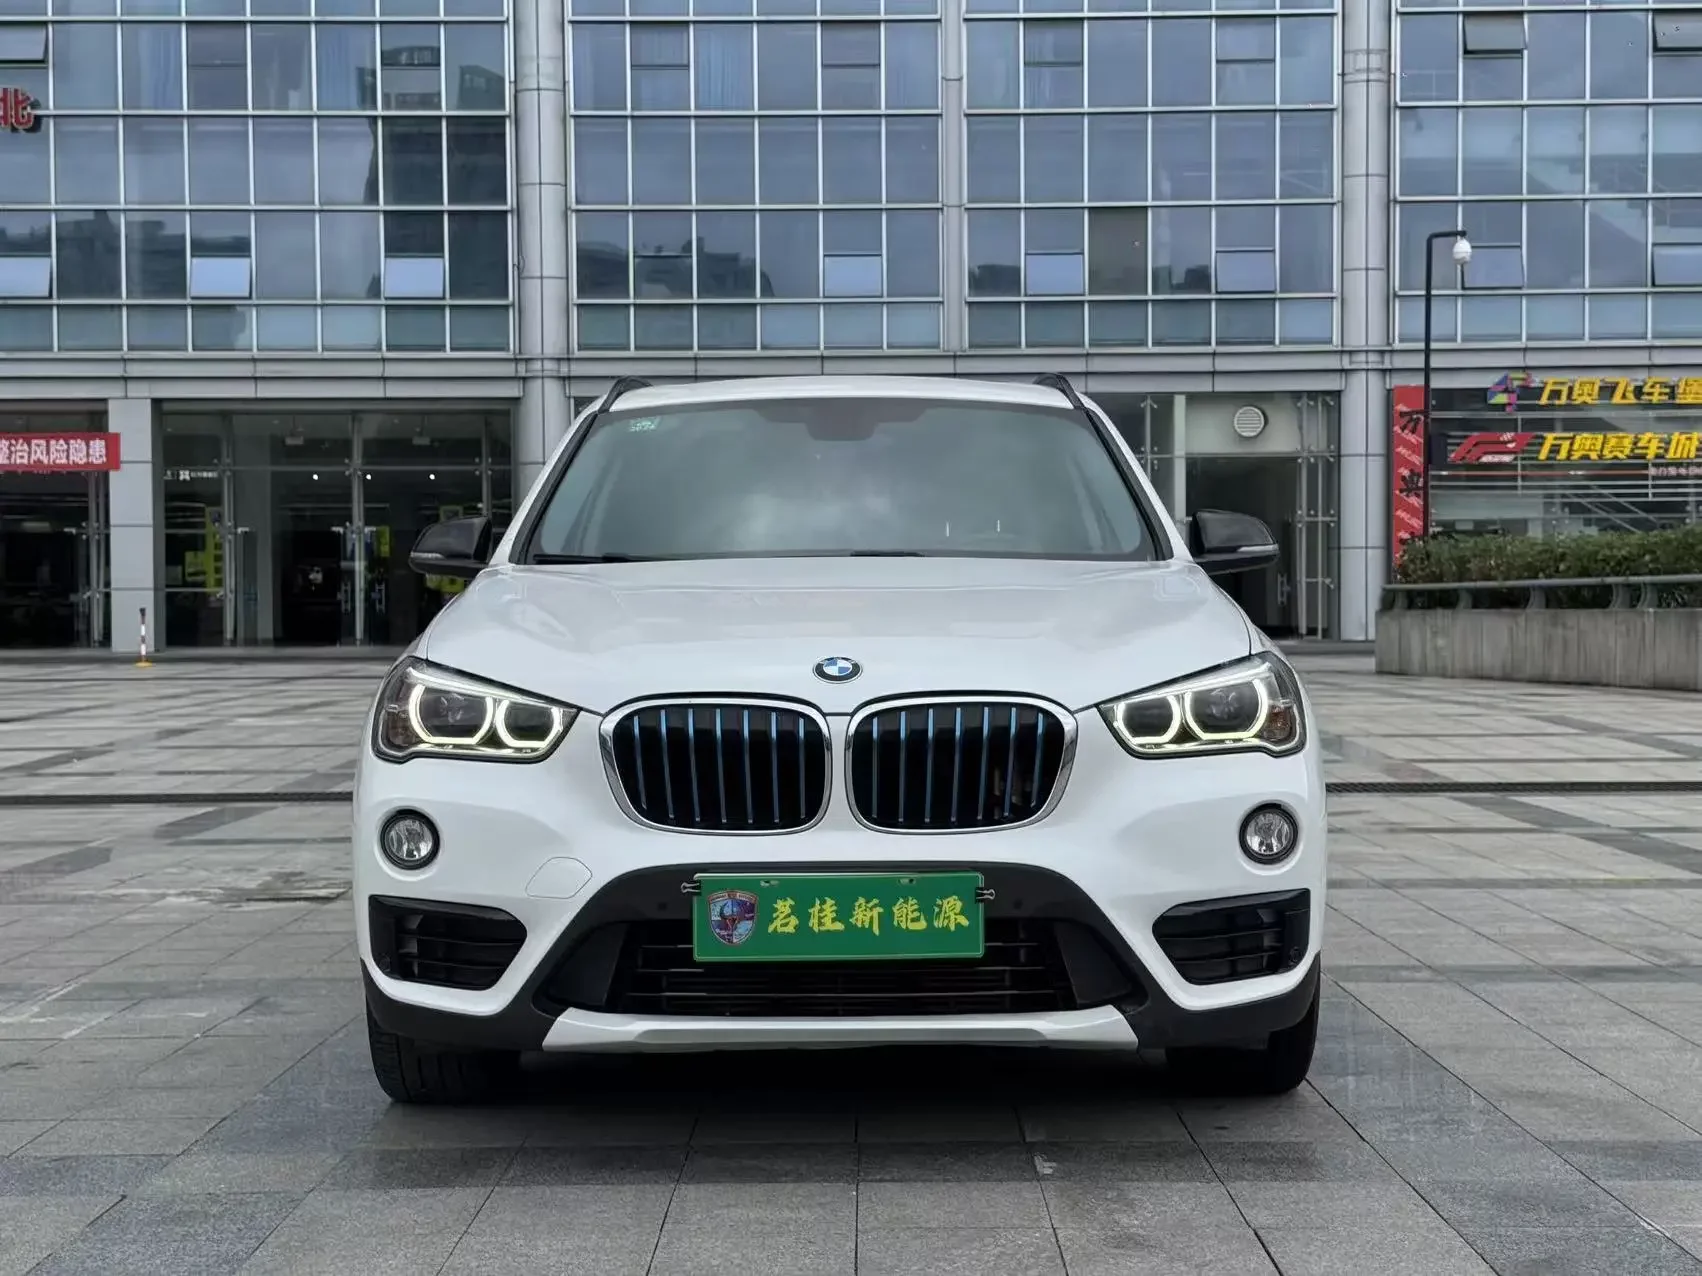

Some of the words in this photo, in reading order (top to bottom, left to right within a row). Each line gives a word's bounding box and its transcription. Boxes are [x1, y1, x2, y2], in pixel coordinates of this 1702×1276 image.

[1537, 377, 1702, 405] 万奥飞车堡
[1537, 431, 1699, 460] 万奥赛车城
